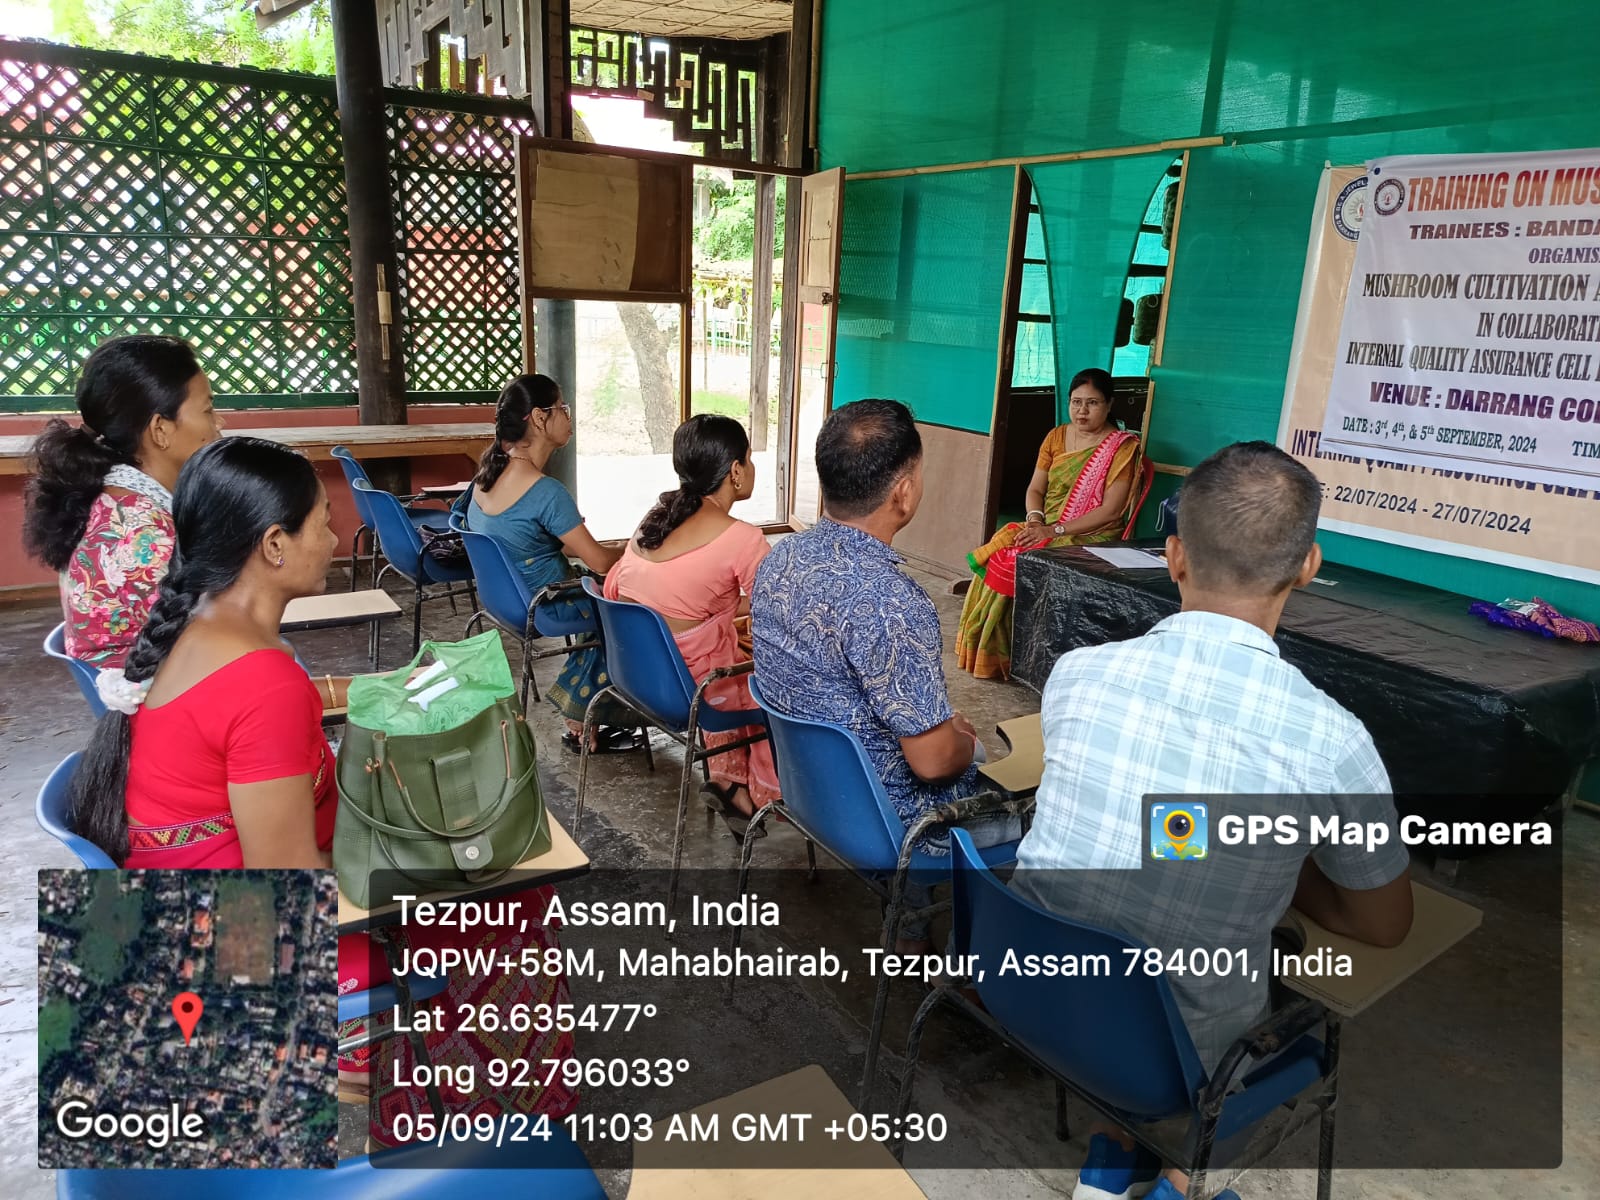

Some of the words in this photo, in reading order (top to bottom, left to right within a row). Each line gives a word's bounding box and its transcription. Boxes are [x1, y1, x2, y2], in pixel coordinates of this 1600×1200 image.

[1408, 171, 1510, 212] TRAINING
[1513, 170, 1550, 208] ON
[1409, 221, 1510, 239] TRAINEES
[1528, 247, 1600, 264] ORGANIS
[1363, 273, 1460, 299] MUSHROOM
[1464, 273, 1591, 301] CULTIVATION
[1476, 312, 1495, 338] IN
[1346, 341, 1404, 369] INTERNAL
[1409, 345, 1469, 372] QUALITY
[1469, 348, 1553, 378] ASSURANCE
[1556, 353, 1592, 381] CELL
[1370, 381, 1433, 408] VENUE
[1445, 388, 1555, 420] DARRANG
[1409, 424, 1418, 440] &
[1436, 427, 1505, 453] SEPTEMBER,
[1507, 435, 1537, 453] 2024
[1334, 485, 1418, 515] 22/07/2024
[1432, 502, 1533, 535] 27/07/2024
